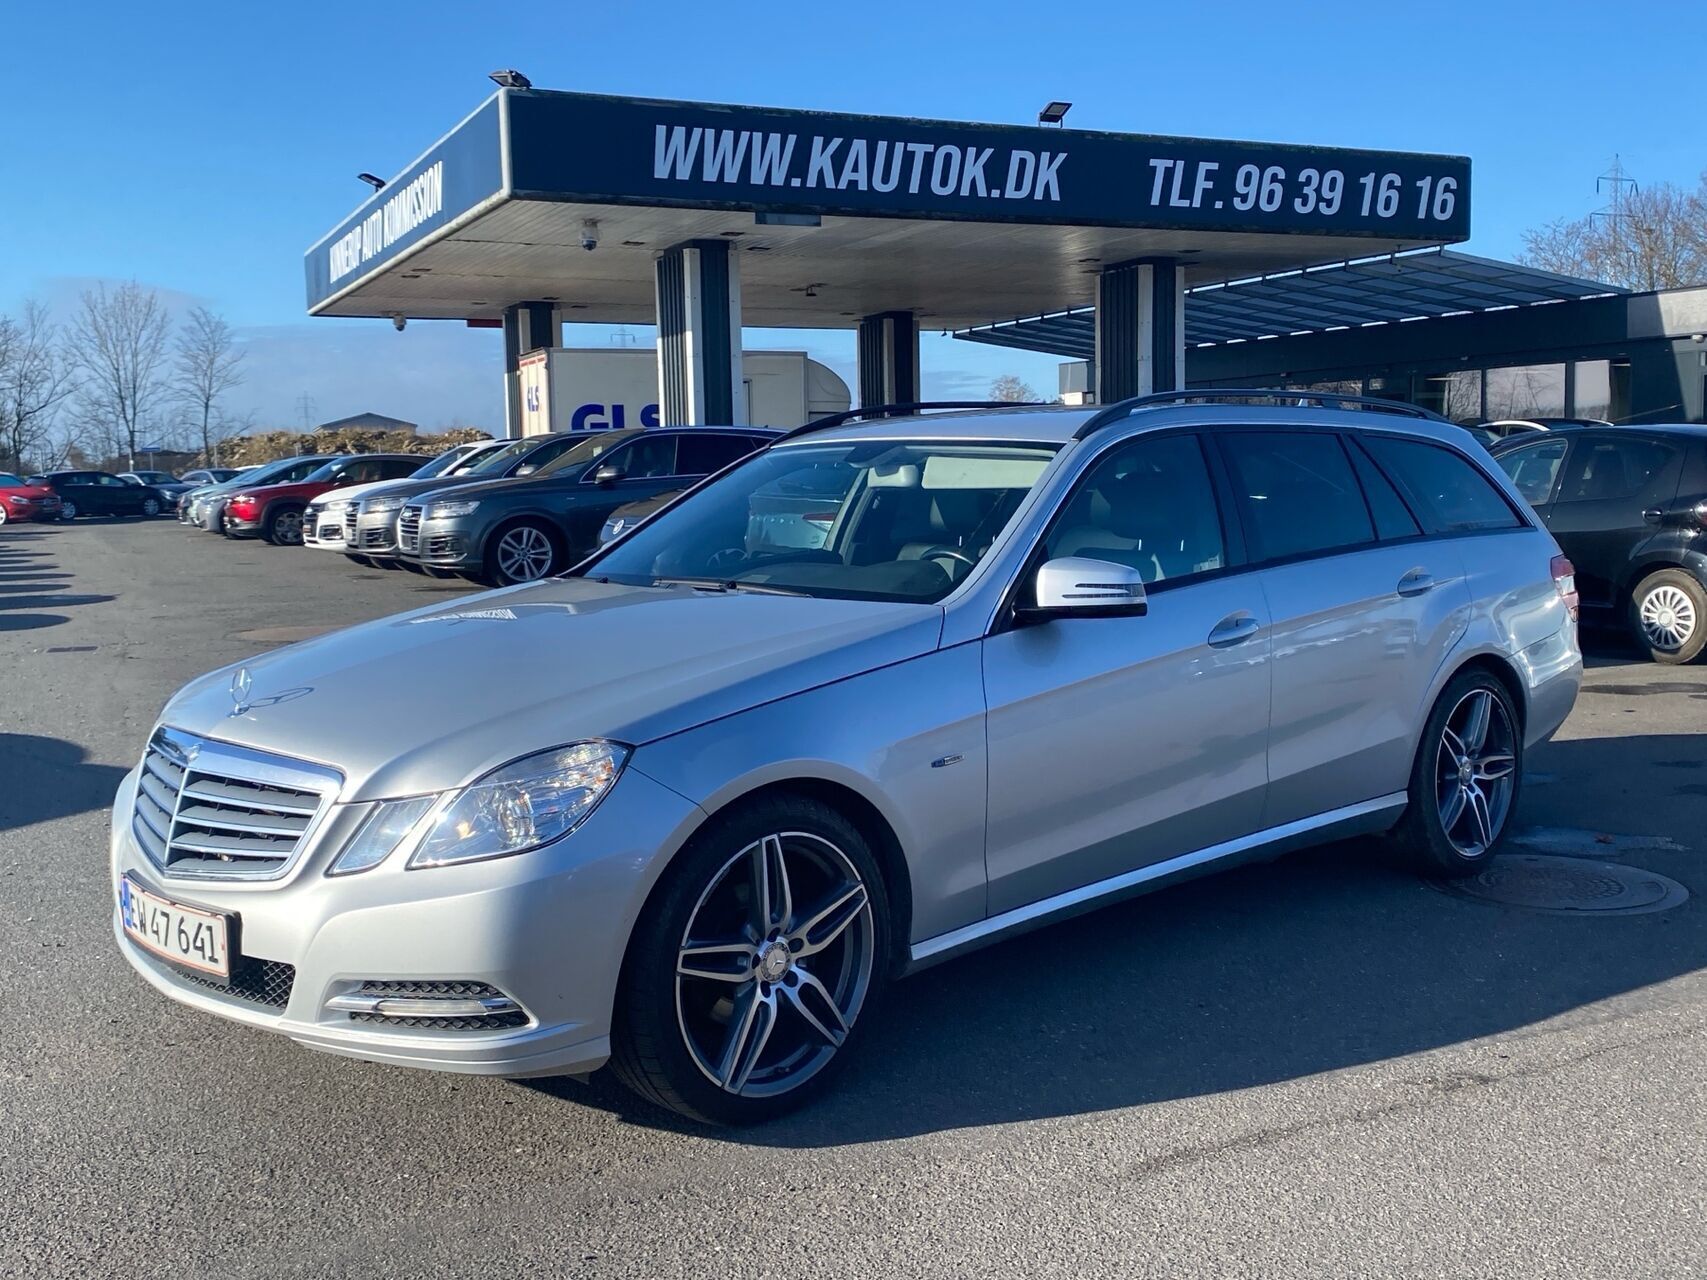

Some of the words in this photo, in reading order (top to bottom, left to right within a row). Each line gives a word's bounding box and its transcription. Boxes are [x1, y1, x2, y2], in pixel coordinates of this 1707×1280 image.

[653, 124, 1069, 201] WWW.KAUTOK.DK
[1149, 158, 1224, 209] TLF.
[1233, 164, 1286, 213] 96
[1294, 168, 1345, 215] 39
[1359, 172, 1402, 218] 16
[1415, 175, 1458, 221] 16
[362, 209, 382, 262] AUTO
[383, 160, 443, 248] KOMMISSION
[130, 893, 147, 937] EW
[151, 907, 170, 947] 47
[177, 916, 219, 964] 641
